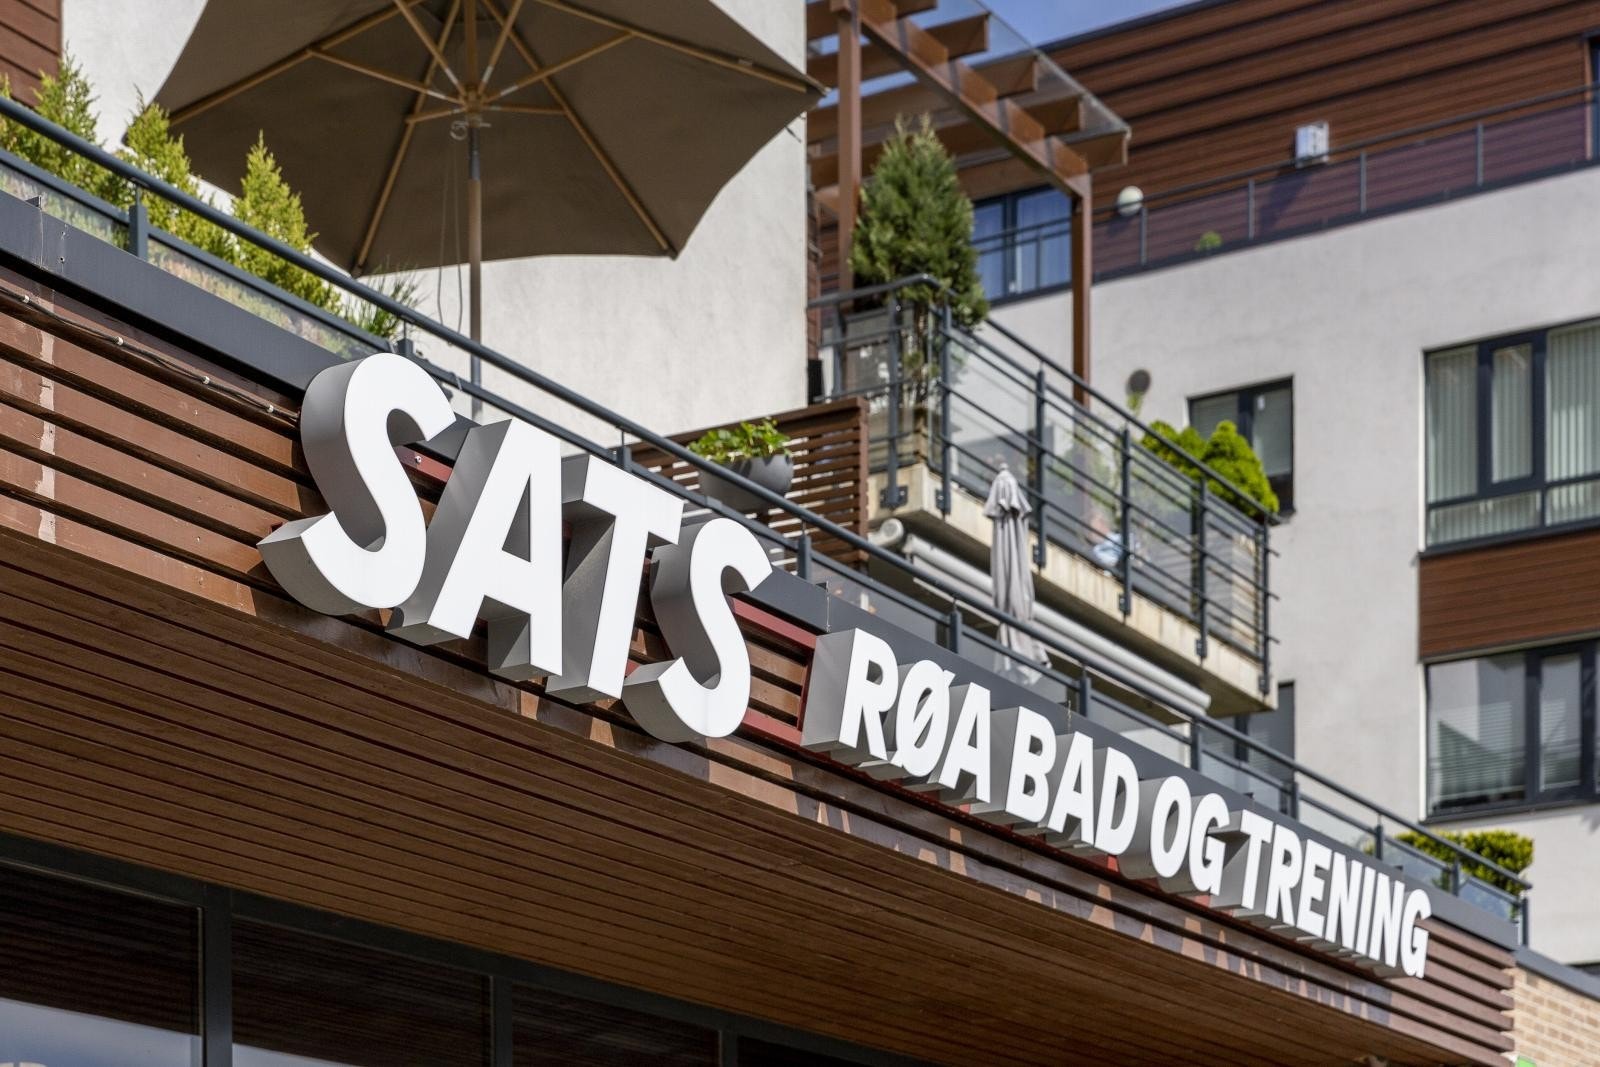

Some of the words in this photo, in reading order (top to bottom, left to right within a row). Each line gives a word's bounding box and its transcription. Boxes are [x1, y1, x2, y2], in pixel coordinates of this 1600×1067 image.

[300, 352, 773, 738] SATS
[839, 627, 991, 803] RØA
[1005, 706, 1140, 855] BAD
[1150, 775, 1230, 896] OG
[1240, 809, 1432, 979] TRENING
